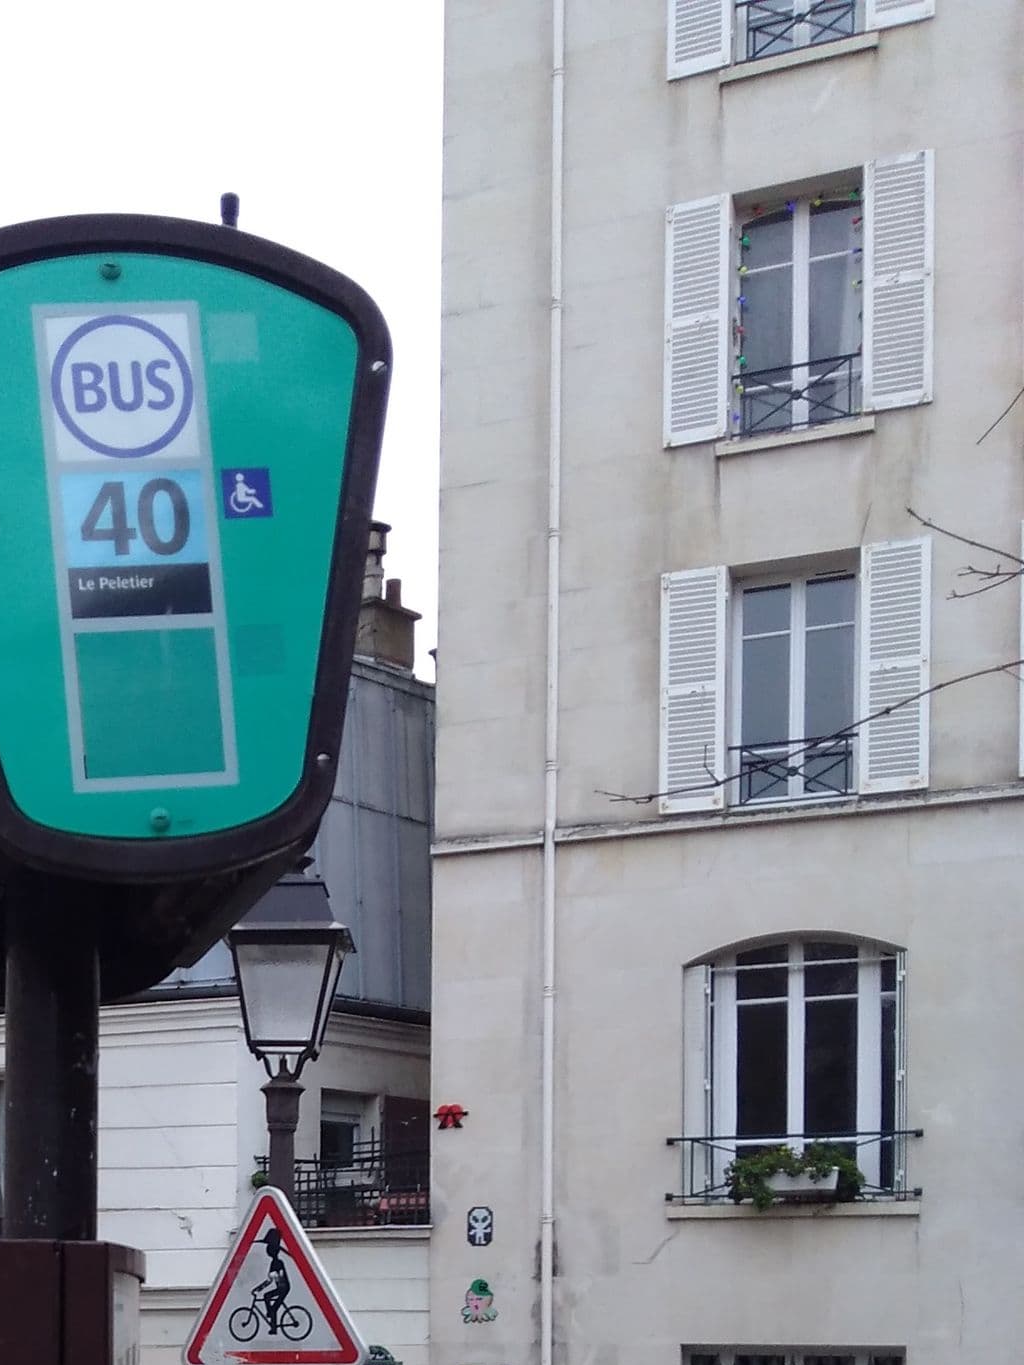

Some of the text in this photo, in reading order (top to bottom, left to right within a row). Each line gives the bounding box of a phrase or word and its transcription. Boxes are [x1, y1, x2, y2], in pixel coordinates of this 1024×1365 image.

[71, 359, 175, 413] BUS
[80, 478, 190, 556] 40
[78, 575, 155, 591] Le Peletier
